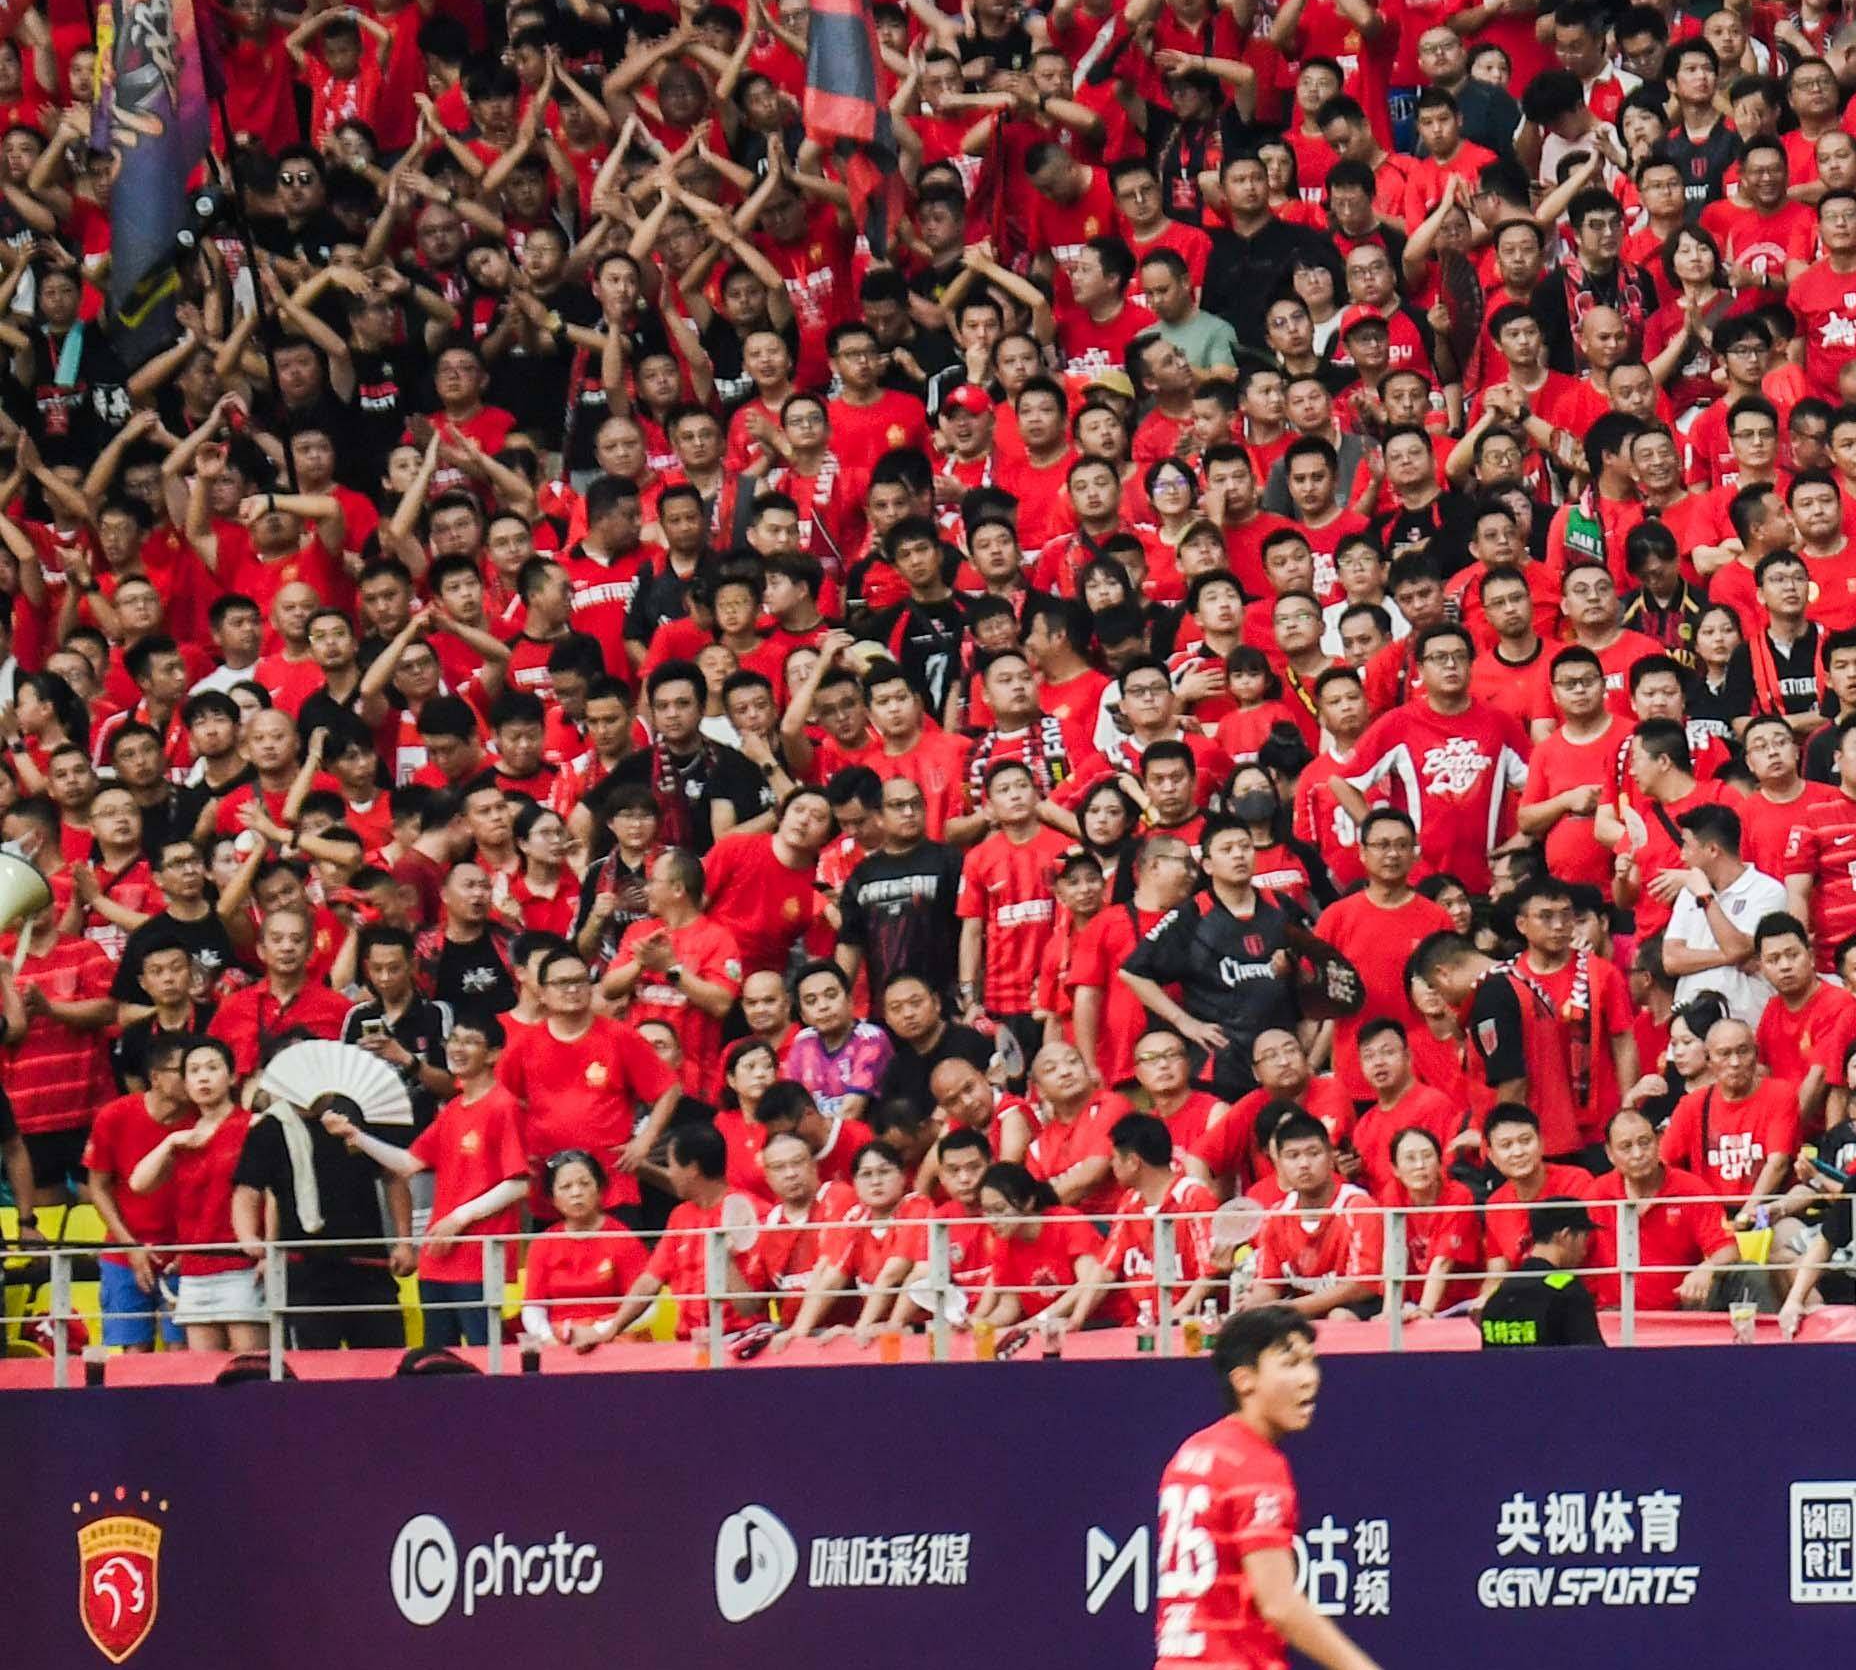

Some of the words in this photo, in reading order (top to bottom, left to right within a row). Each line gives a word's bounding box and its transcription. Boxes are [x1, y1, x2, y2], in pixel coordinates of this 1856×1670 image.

[1496, 1490, 1682, 1557] 央视体育
[404, 1539, 447, 1600] IC
[464, 1531, 603, 1617] photo
[809, 1533, 970, 1587] 咪咕彩媒
[1551, 1565, 1700, 1607] SPORTS
